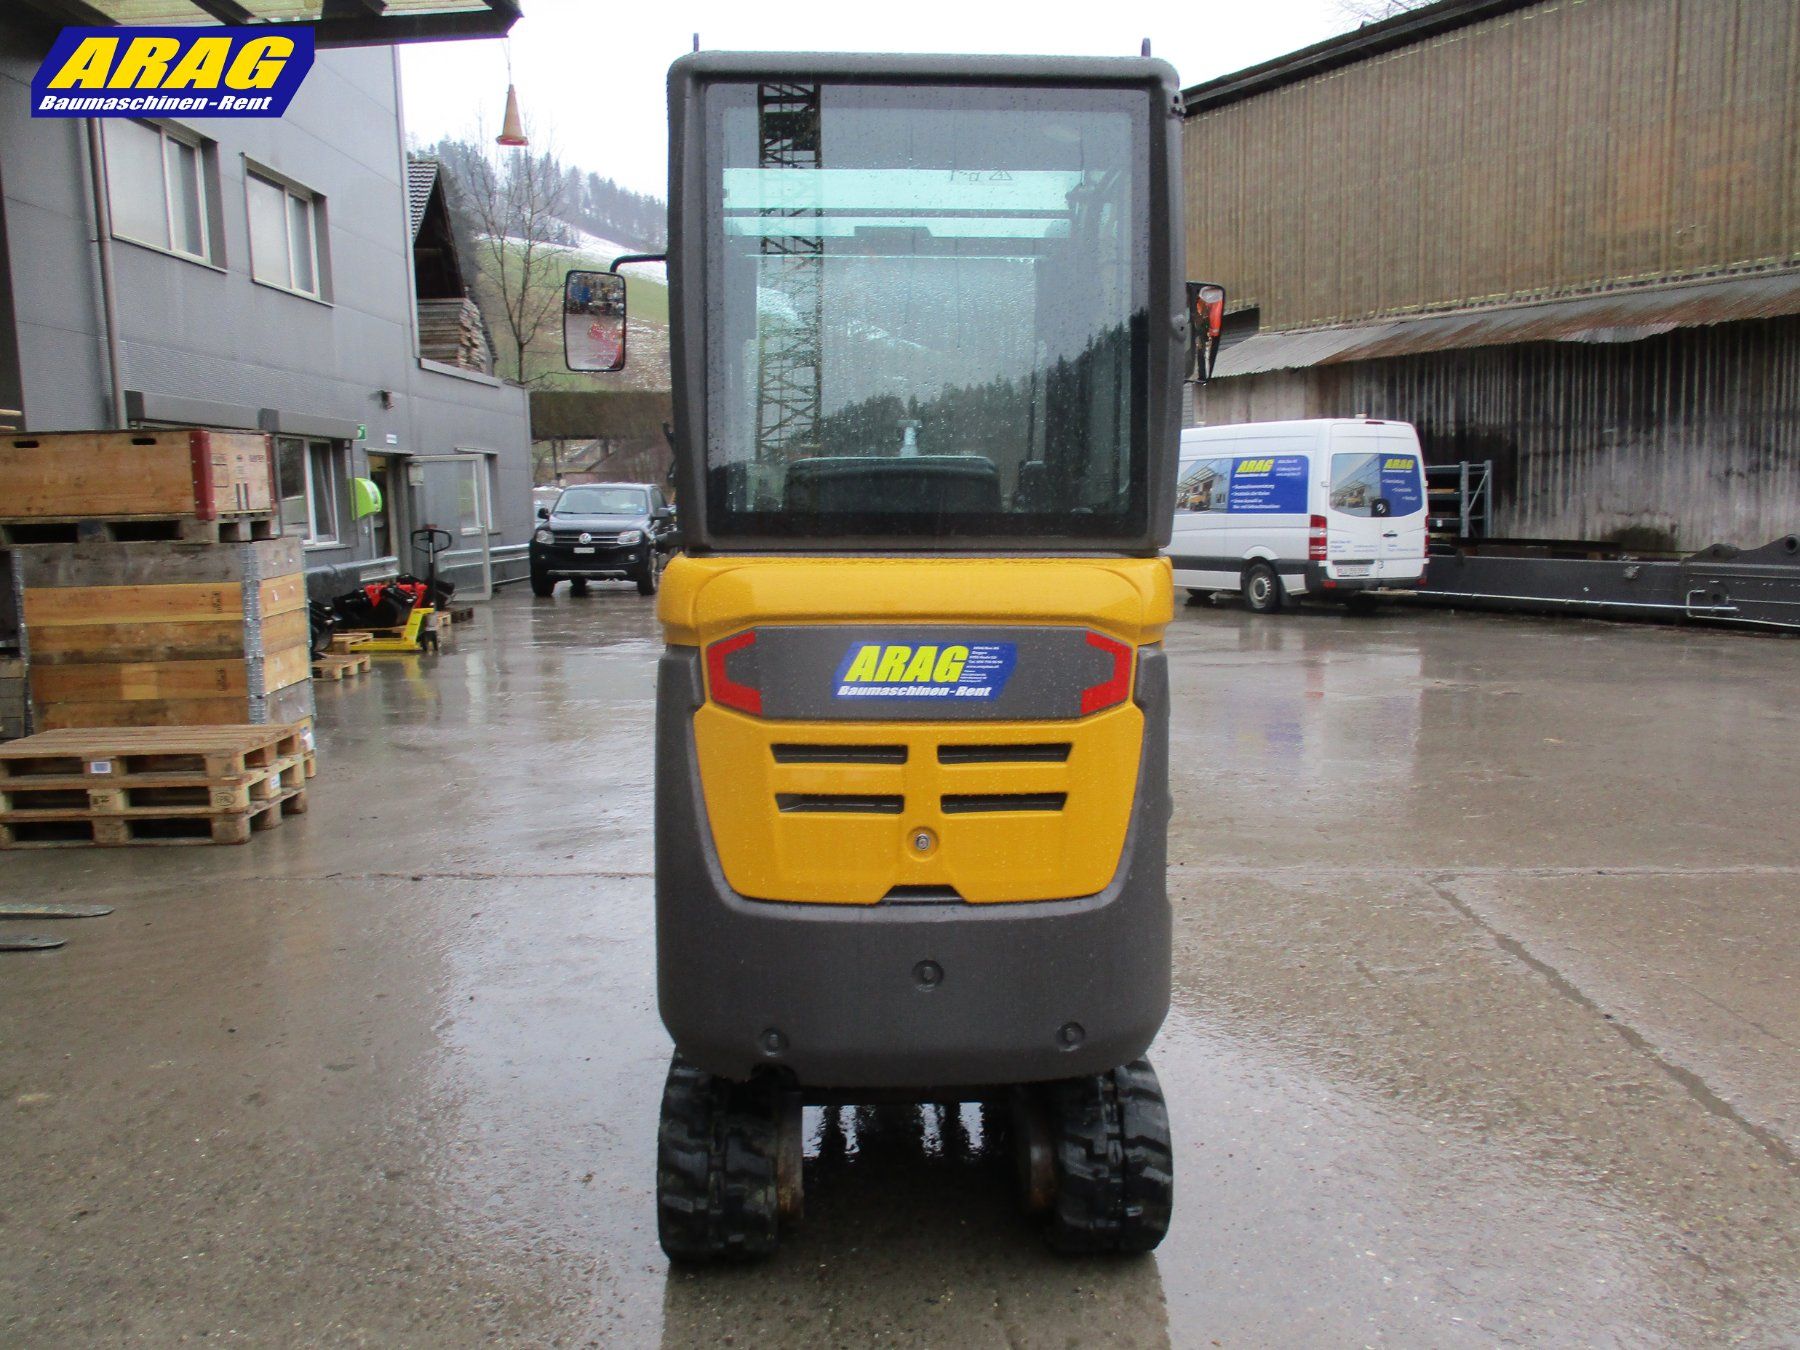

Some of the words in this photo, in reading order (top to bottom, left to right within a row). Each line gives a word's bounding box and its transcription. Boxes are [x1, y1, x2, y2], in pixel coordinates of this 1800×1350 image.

[1235, 459, 1275, 473] ARAG
[1383, 458, 1415, 470] ARAG
[843, 645, 969, 683] ARAG
